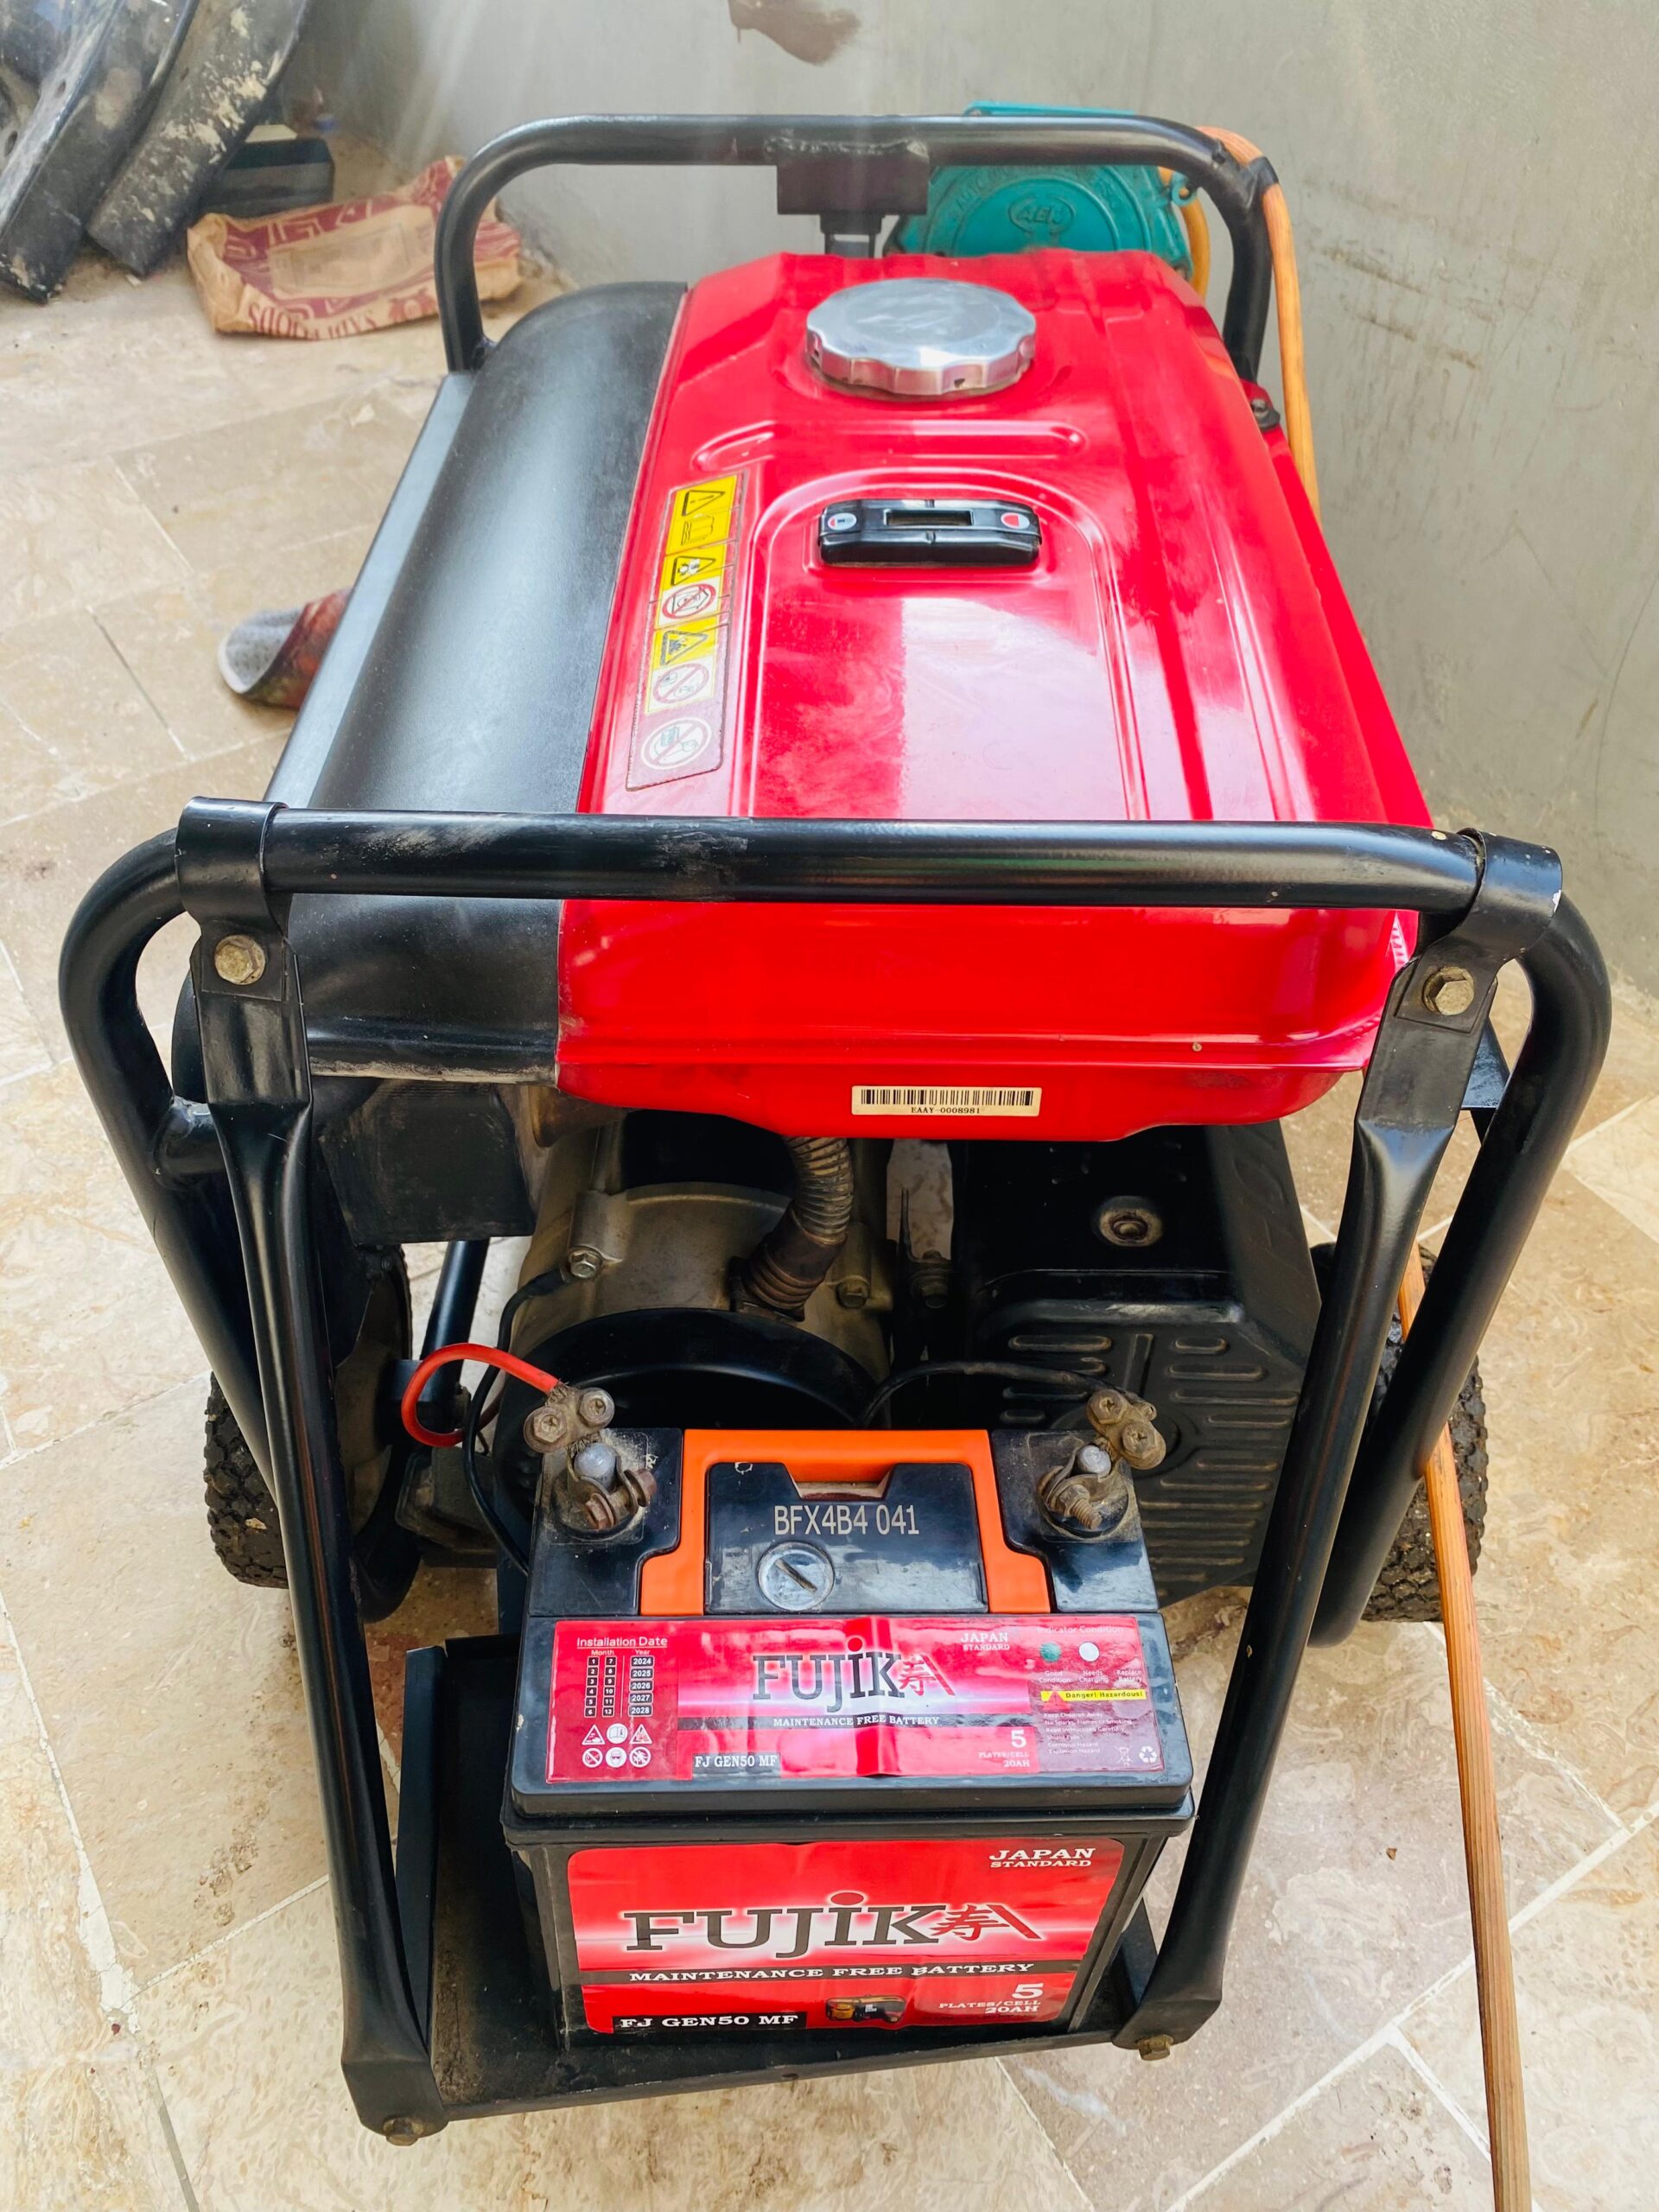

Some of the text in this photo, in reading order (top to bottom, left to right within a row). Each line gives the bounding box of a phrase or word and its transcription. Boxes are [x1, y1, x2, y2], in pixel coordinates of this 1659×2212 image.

[774, 1504, 920, 1535] BFX4B4 041
[576, 1636, 668, 1647] Installation Date
[961, 1632, 1008, 1643] JAPAN
[773, 1714, 939, 1727] MAINTENANCE FREE BATTERY
[1010, 1729, 1027, 1749] 5
[694, 1755, 778, 1768] FJ GEN50 MF
[1003, 1759, 1030, 1768] 20AH
[988, 1847, 1096, 1860] JAPAN
[990, 1859, 1092, 1868] STANDARD
[629, 1962, 1035, 1981] MAINTENANCE FREE BATTERY
[1012, 1982, 1044, 1999] 5
[938, 1999, 1042, 2008] PLATES/CELL
[985, 2005, 1039, 2014] 20AH
[620, 2014, 798, 2028] FJ GEN50 MF
